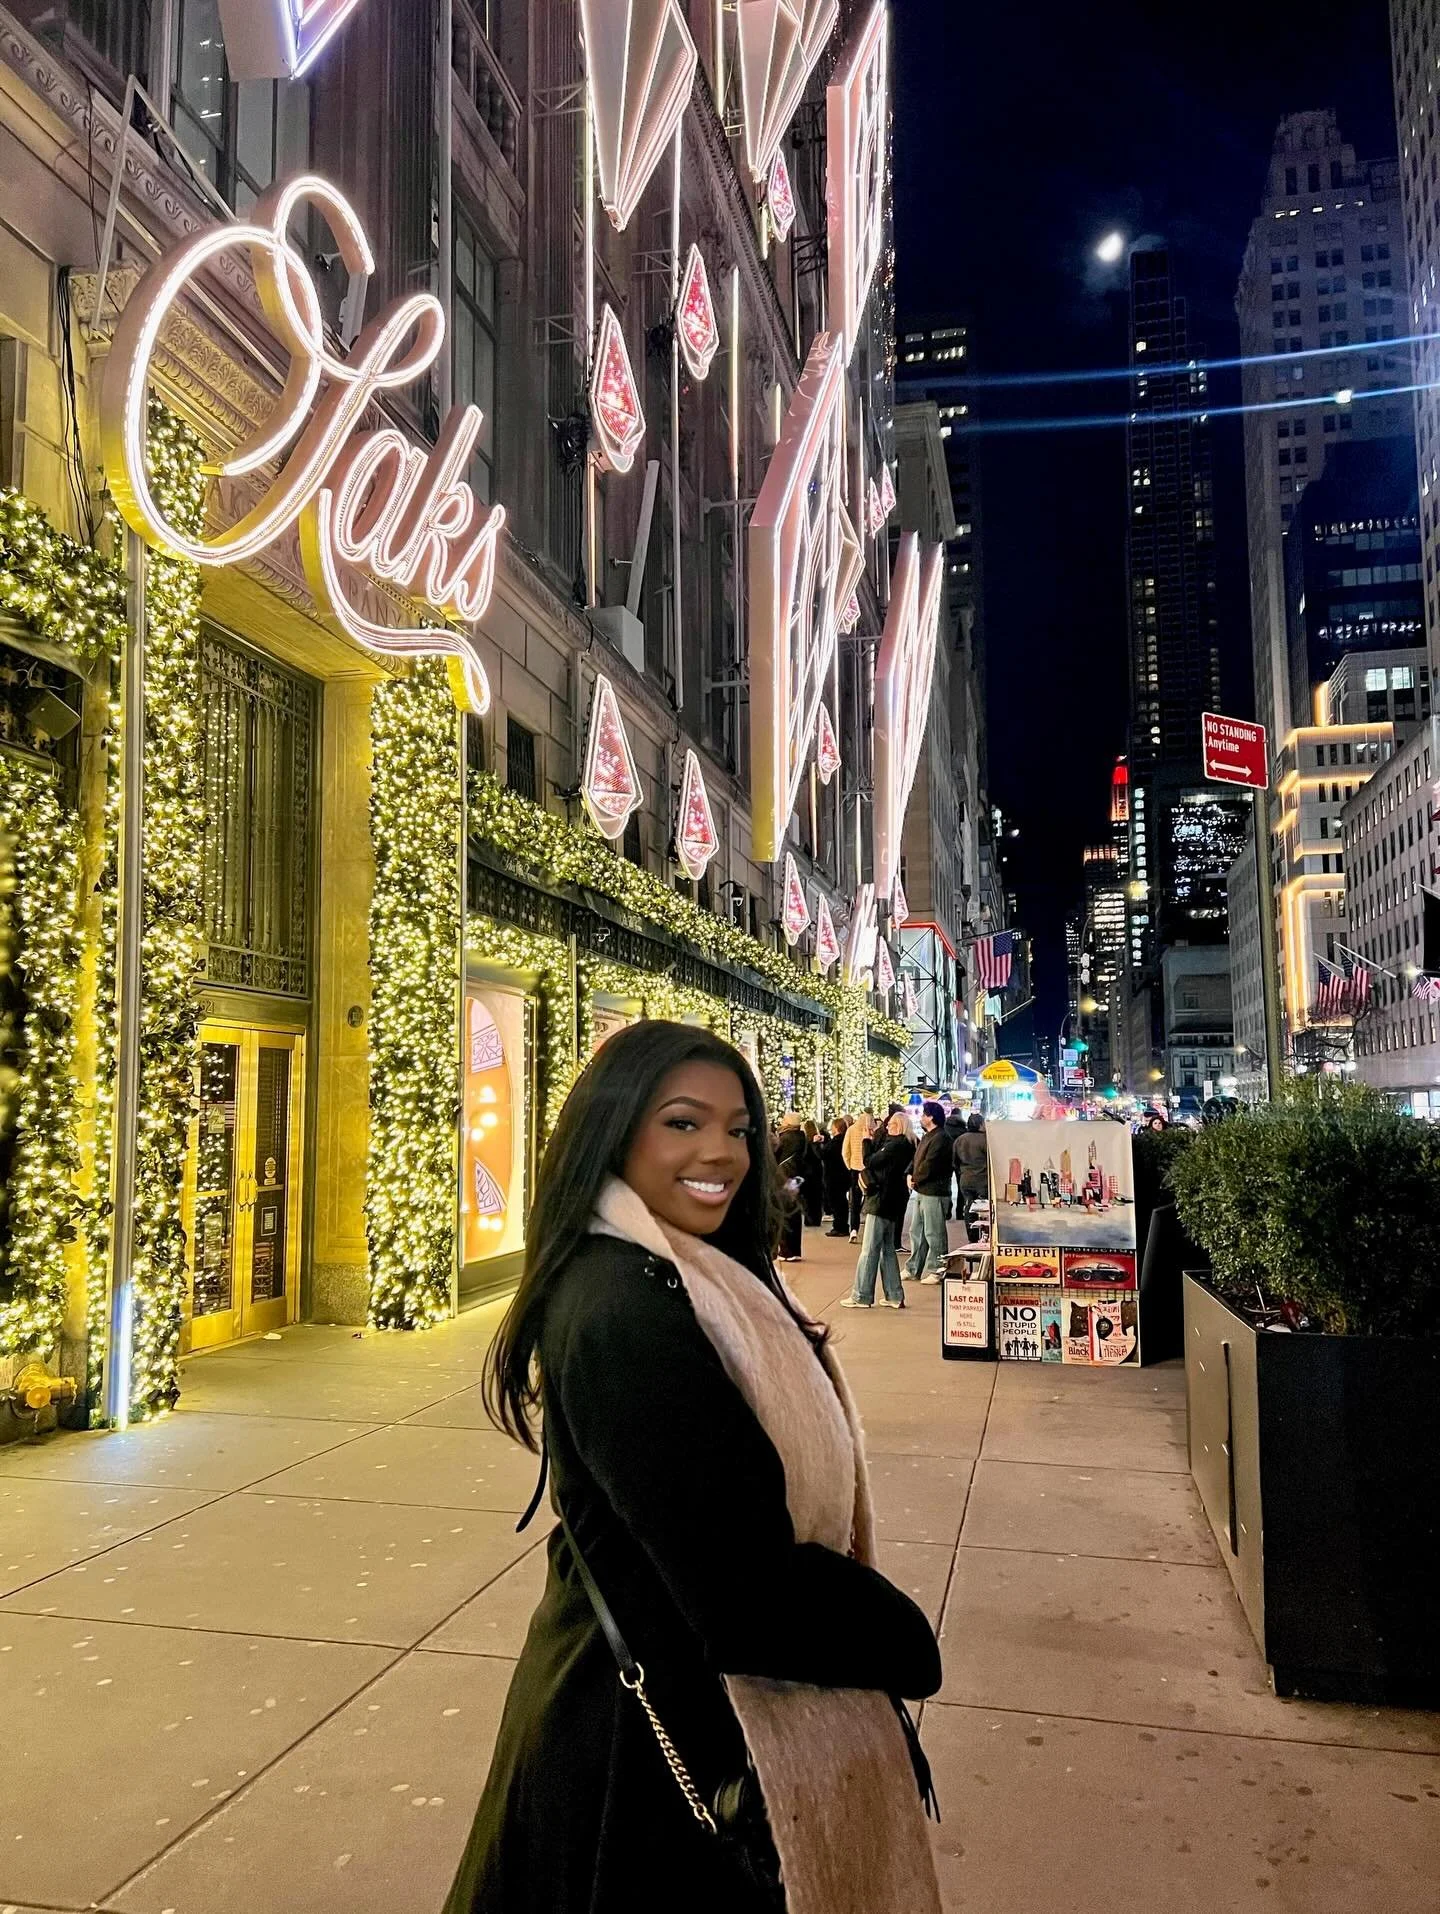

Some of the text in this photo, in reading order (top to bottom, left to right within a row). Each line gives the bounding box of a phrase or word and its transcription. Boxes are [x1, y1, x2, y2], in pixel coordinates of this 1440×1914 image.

[112, 173, 506, 716] Saks
[1206, 720, 1257, 742] NO STANDING
[1208, 736, 1240, 753] Anytime
[997, 1246, 1056, 1258] Ferrari
[949, 1295, 984, 1304] LAST CAR
[1002, 1306, 1037, 1322] NO
[1002, 1321, 1037, 1329] STUPID
[950, 1330, 983, 1339] MISSING
[1002, 1328, 1038, 1336] PEOPLE
[1068, 1346, 1090, 1356] Black
